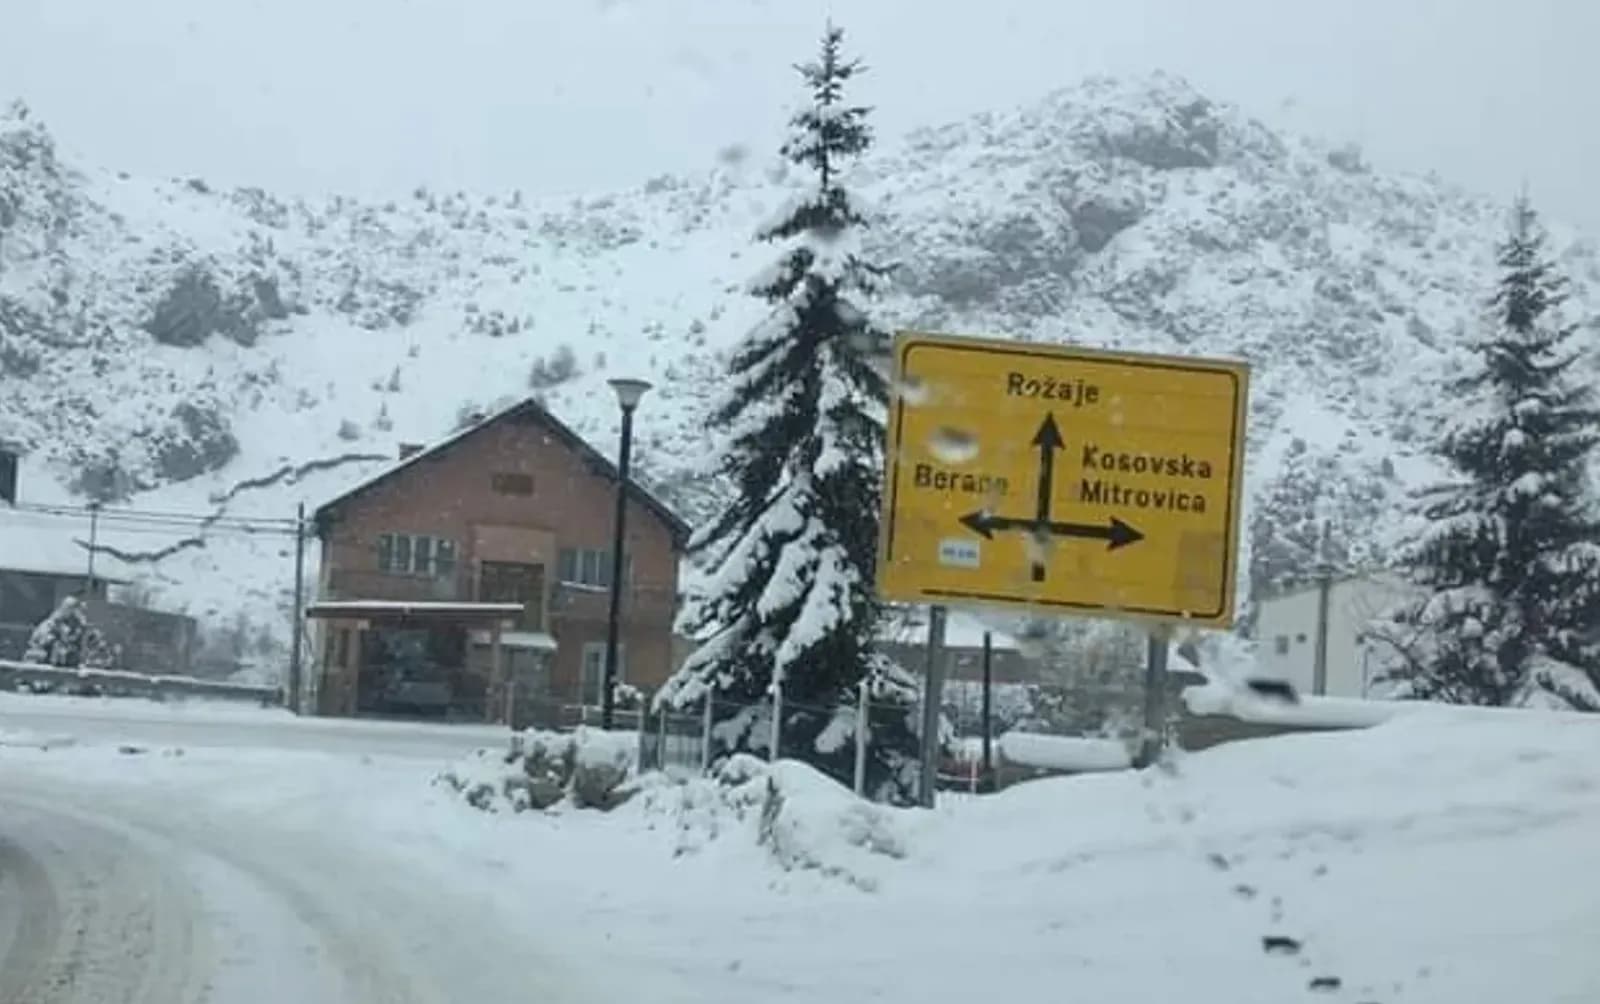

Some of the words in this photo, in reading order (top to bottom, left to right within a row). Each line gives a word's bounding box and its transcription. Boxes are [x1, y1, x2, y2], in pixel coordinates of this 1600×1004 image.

[1007, 373, 1099, 407] Rožaje
[1082, 445, 1213, 479] Kosovska
[1080, 479, 1207, 514] Mitrovica
